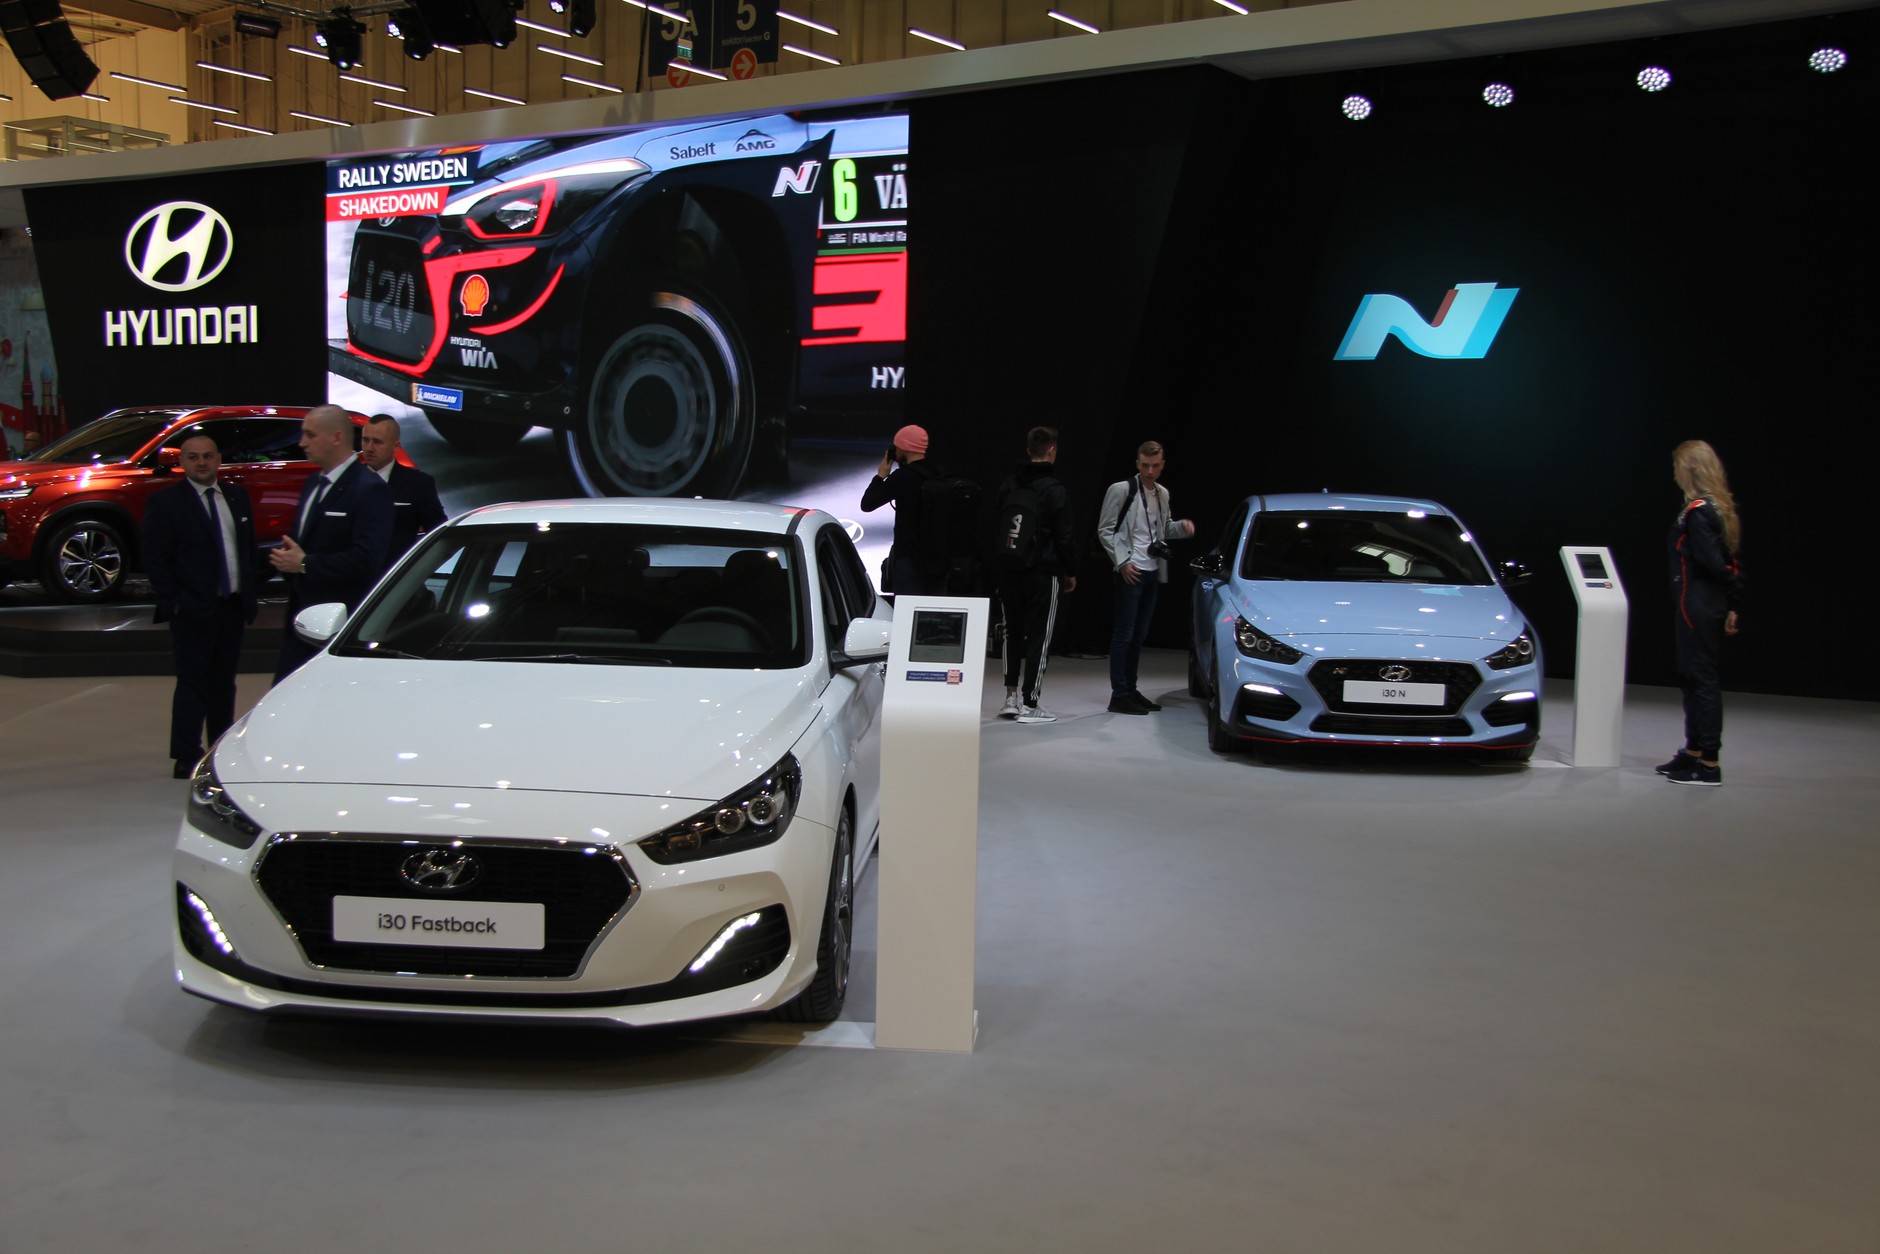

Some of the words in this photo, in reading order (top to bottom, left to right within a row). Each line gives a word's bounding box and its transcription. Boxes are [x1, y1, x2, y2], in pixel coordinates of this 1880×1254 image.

[736, 0, 757, 31] 5
[763, 31, 771, 41] G
[670, 142, 716, 161] Sabelt
[735, 140, 776, 153] AMG
[339, 165, 391, 188] RALLY
[393, 157, 468, 184] SWEDEN
[833, 158, 858, 222] 6
[339, 192, 439, 217] SHAKEDOWN
[852, 232, 868, 244] FIA
[106, 304, 259, 347] HYUNDAI
[450, 336, 482, 348] HYUNDAI
[870, 366, 905, 389] HY
[1007, 513, 1023, 549] FILA
[1382, 689, 1397, 698] i30
[1398, 690, 1406, 698] N
[378, 912, 406, 930] i30
[412, 915, 497, 934] Fastback
